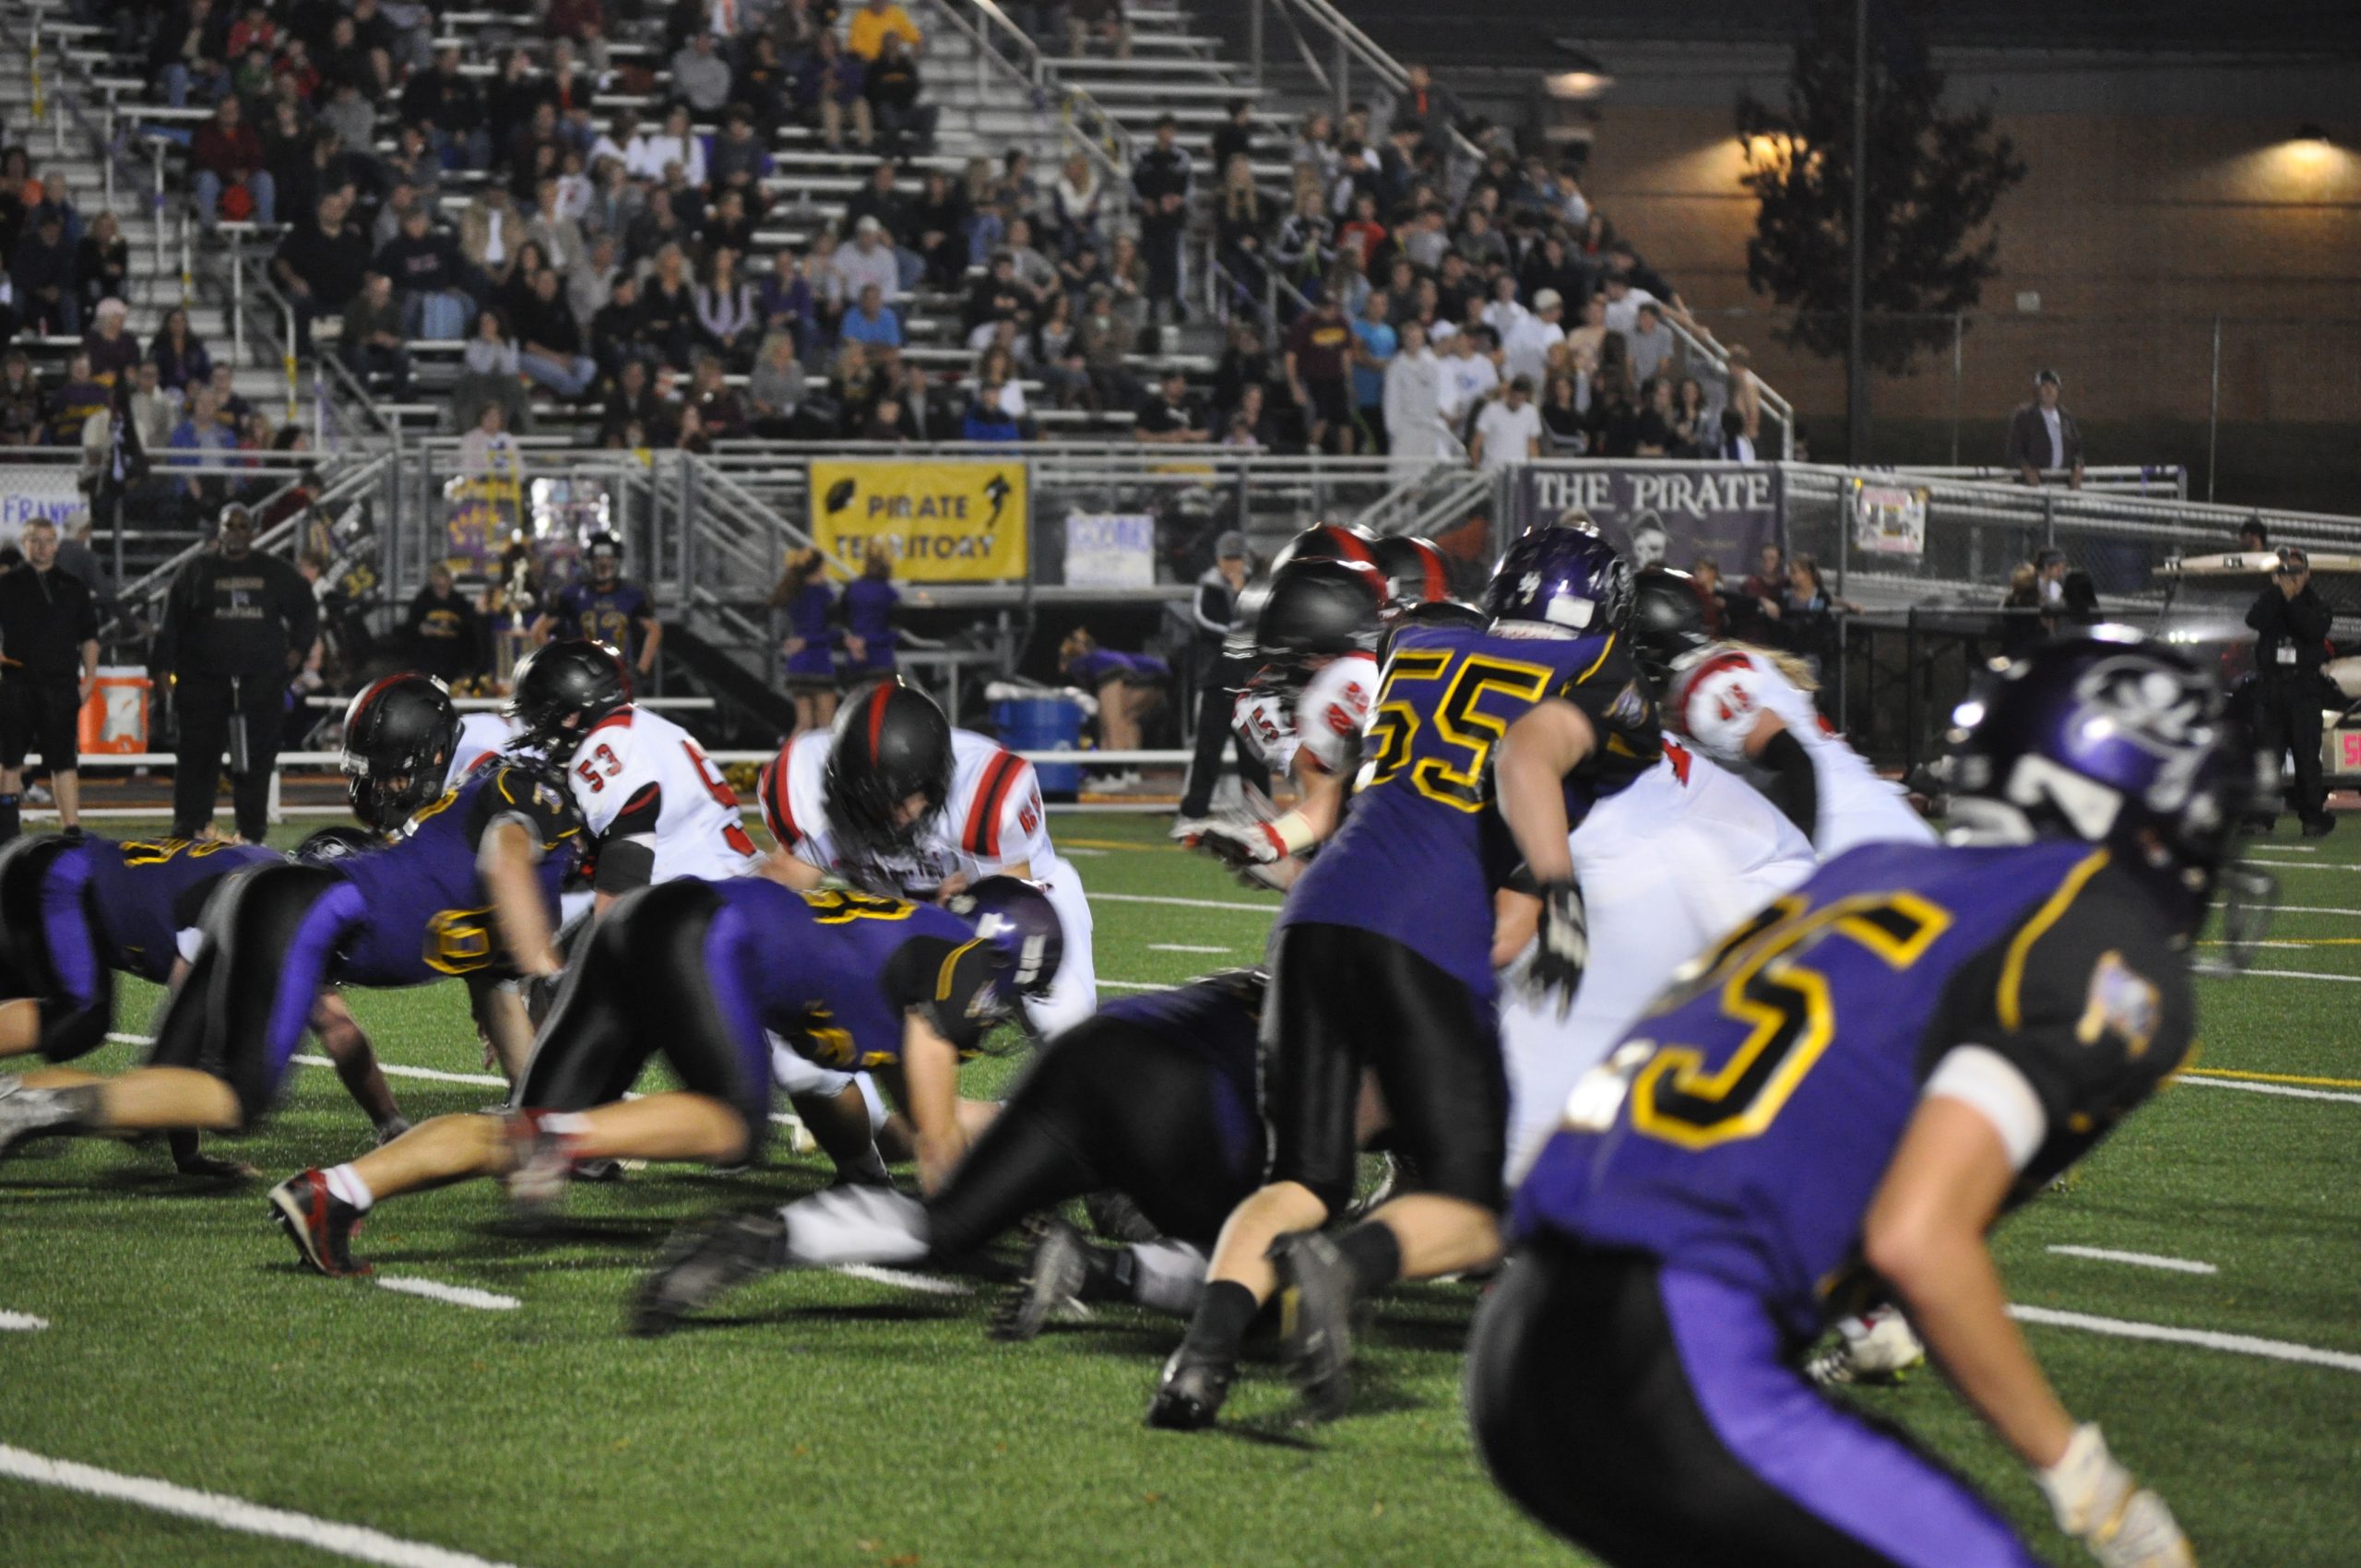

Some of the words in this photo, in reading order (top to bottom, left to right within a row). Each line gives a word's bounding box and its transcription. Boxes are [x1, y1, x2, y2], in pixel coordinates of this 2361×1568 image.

[867, 495, 968, 518] PIRATE
[1533, 470, 1615, 510] THE
[1626, 471, 1775, 520] PIRATE
[1356, 647, 1555, 814] 55
[575, 742, 623, 793] 53
